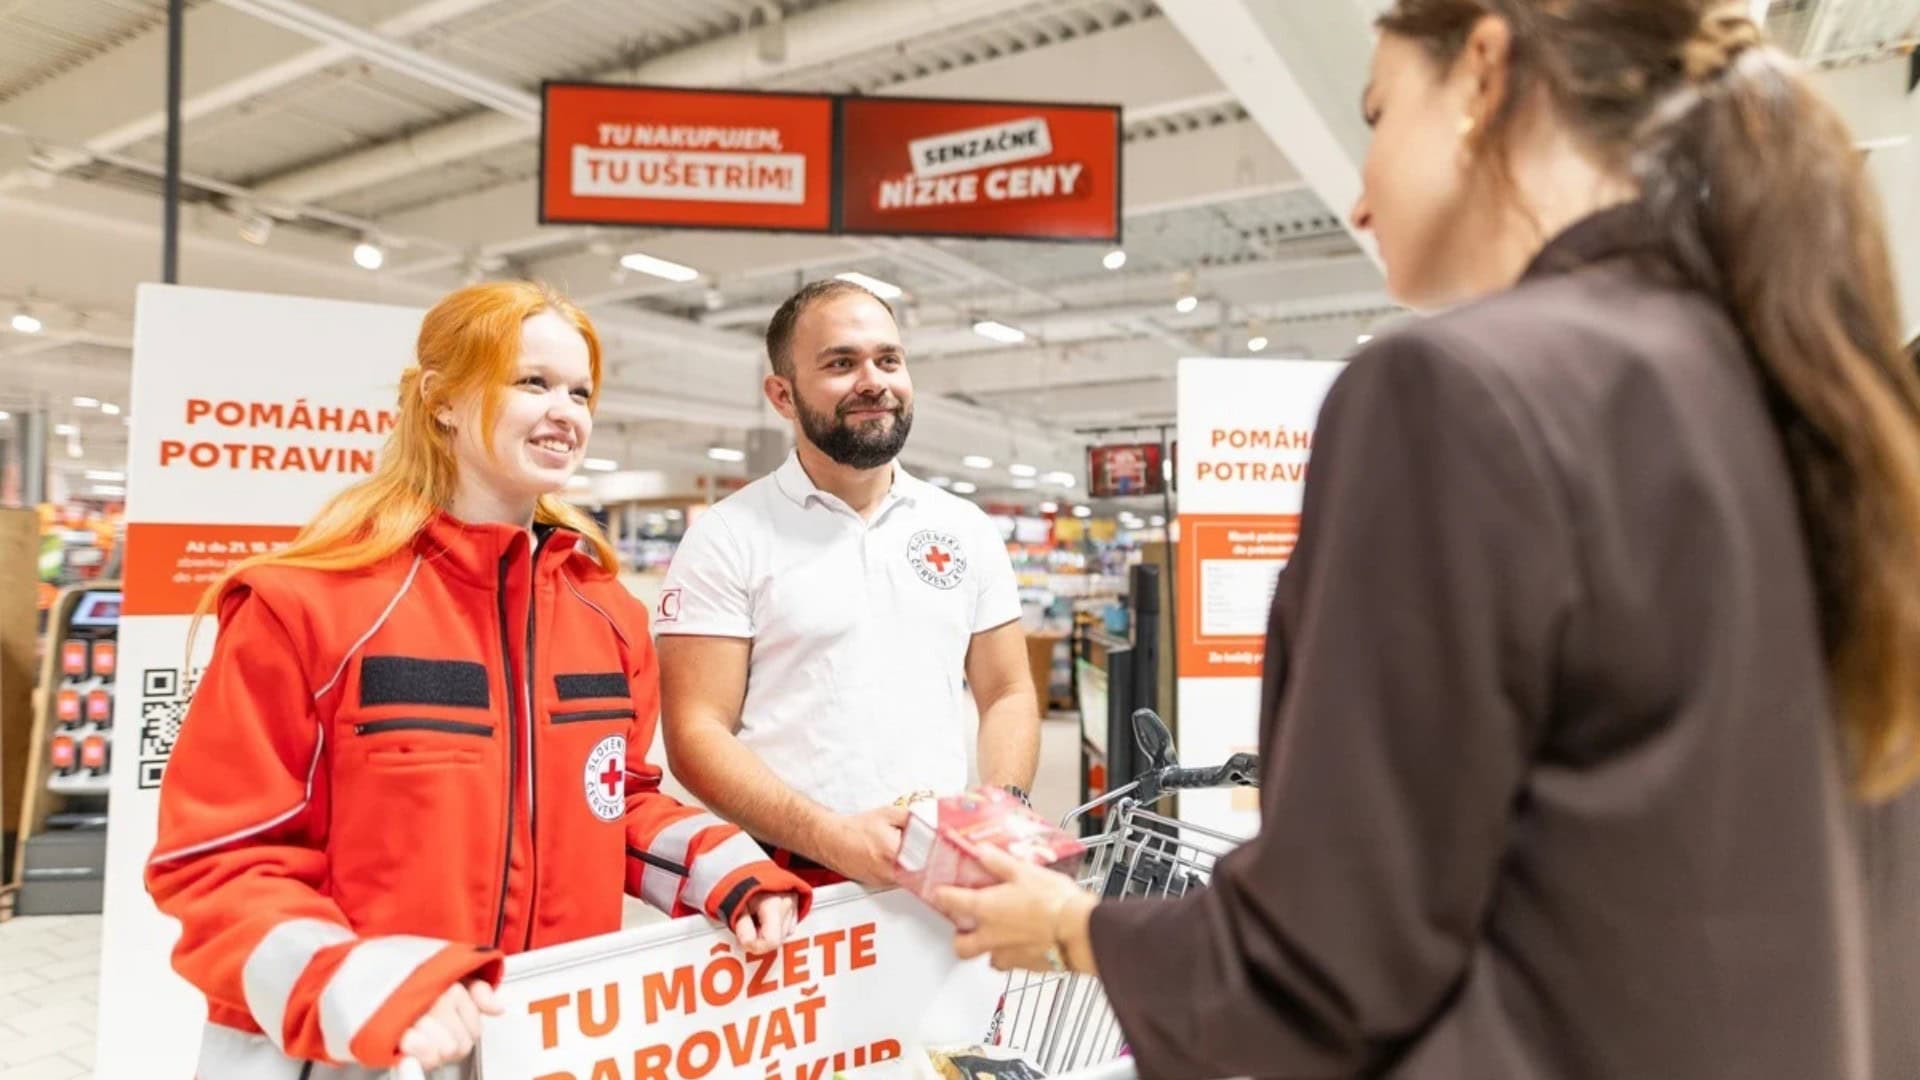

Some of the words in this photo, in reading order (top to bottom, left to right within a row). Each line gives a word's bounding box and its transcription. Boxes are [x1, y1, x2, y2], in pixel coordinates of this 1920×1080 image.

[598, 123, 632, 147] TU
[633, 123, 783, 153] NAKUPUJEM,
[924, 128, 1038, 167] SENZAČNE
[587, 158, 629, 183] TU
[639, 154, 793, 191] UŠETRÍM!
[878, 173, 979, 209] NÍZKE
[984, 163, 1083, 200] CENY
[1211, 424, 1311, 449] POMÁH
[159, 440, 375, 473] POTRAVIN
[528, 982, 620, 1050] TU
